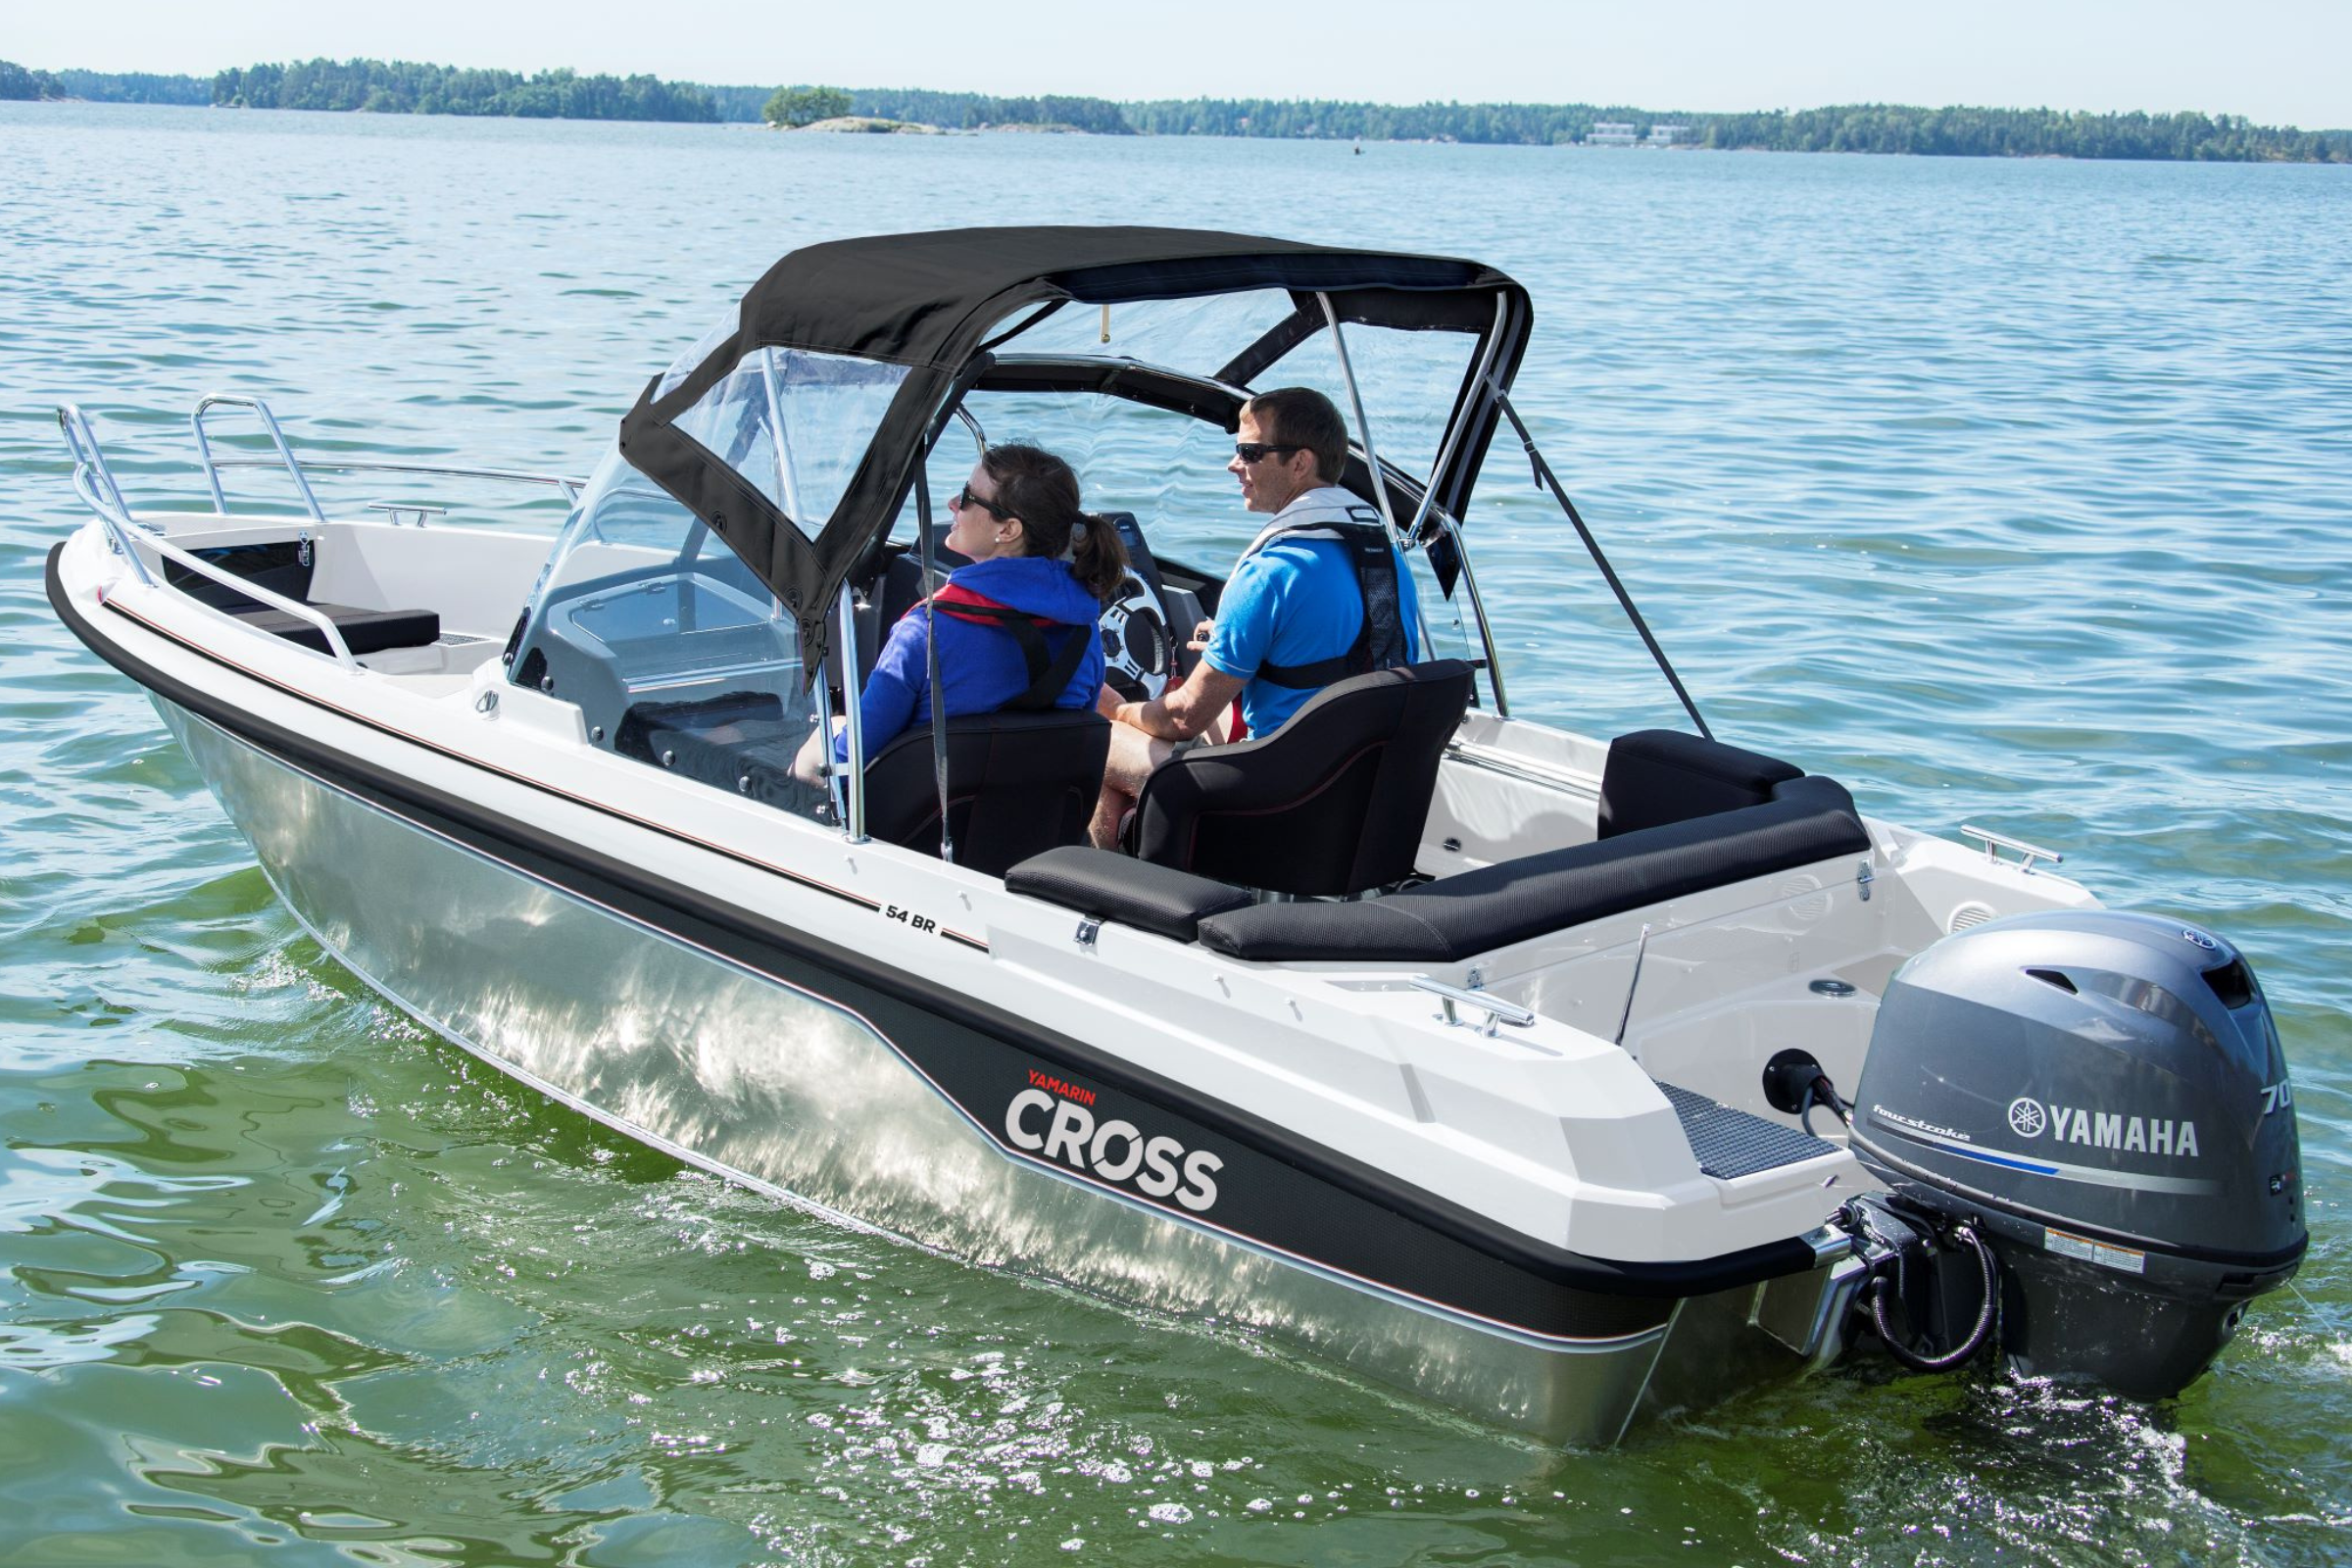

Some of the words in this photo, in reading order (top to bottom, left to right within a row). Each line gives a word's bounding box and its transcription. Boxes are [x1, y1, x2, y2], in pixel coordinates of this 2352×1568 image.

[886, 905, 908, 922] 54
[911, 914, 936, 934] BR
[1028, 1068, 1096, 1106] YAMARIN
[2260, 1078, 2291, 1114] 70
[2050, 1104, 2199, 1156] YAMAHA
[1005, 1089, 1224, 1211] CROSS
